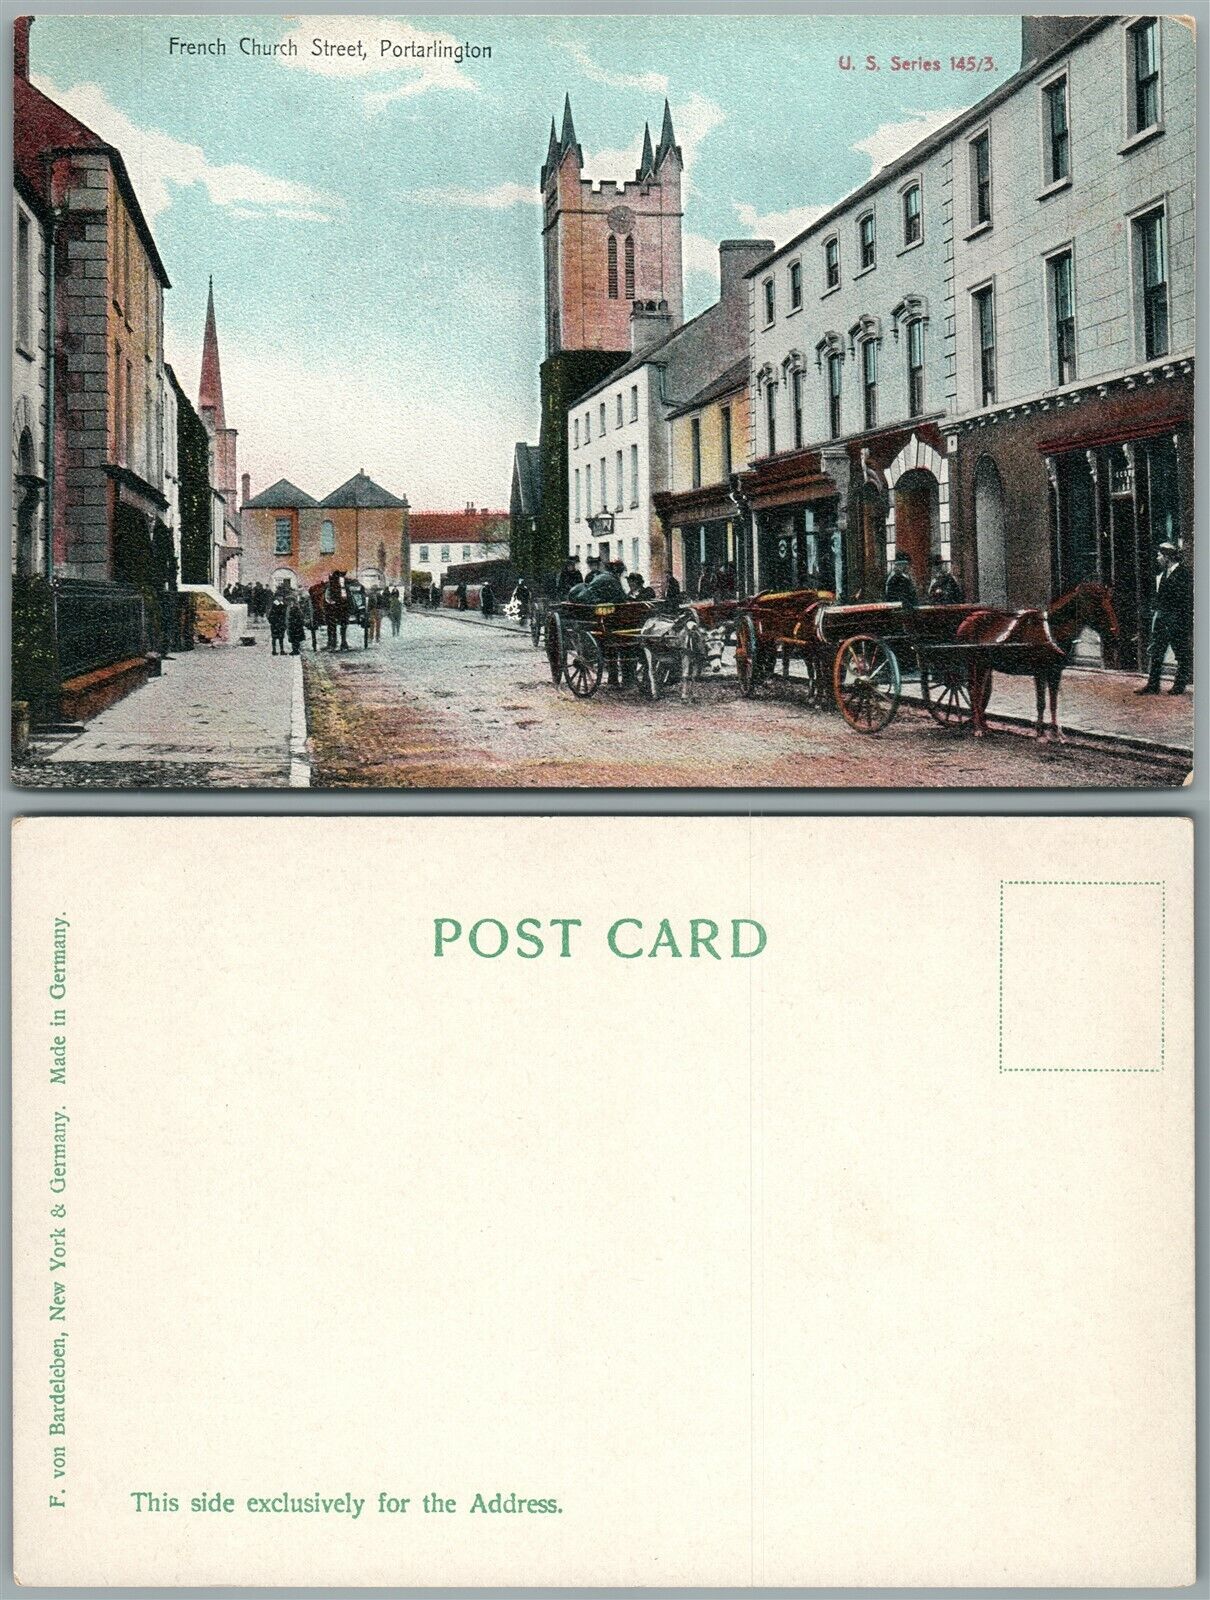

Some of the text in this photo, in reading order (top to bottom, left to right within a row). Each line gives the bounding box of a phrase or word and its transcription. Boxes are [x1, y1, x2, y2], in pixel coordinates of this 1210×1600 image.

[170, 38, 492, 63] French Church Street, Portarlington
[838, 55, 999, 72] U. S. Series 145/3.
[433, 917, 768, 960] POST CARD
[49, 911, 71, 1508] F. von Bardeleben, New York & Germany. Made in Germany.
[130, 1492, 563, 1520] This side exclusively for the Address.
